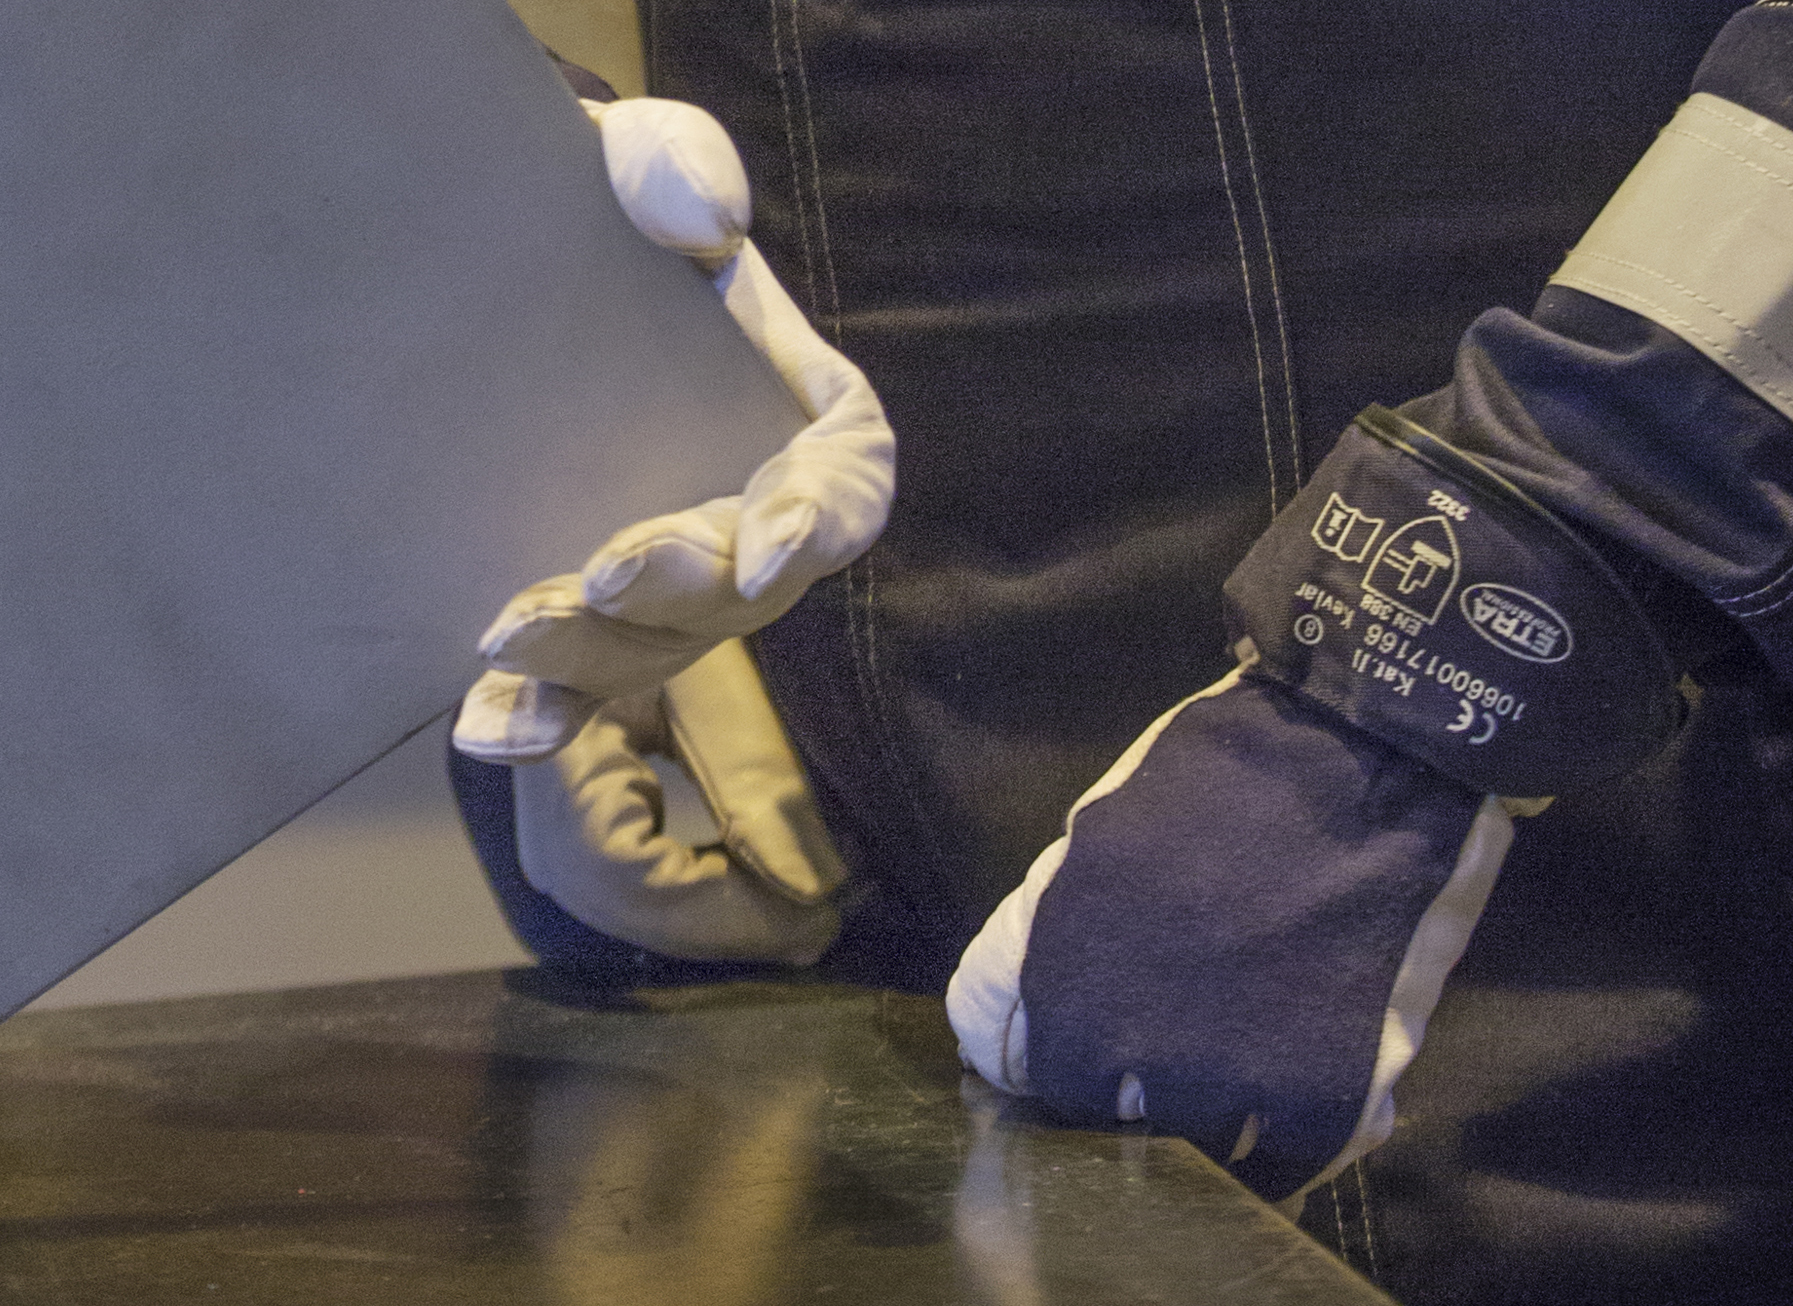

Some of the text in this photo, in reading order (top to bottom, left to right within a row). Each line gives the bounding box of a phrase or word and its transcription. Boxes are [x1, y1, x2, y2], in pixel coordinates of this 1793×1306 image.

[1427, 489, 1471, 521] 3322
[1295, 582, 1355, 629] Kevlar
[1360, 593, 1423, 636] EN 388
[1472, 597, 1558, 656] ETRA
[1363, 623, 1527, 721] 10660017166
